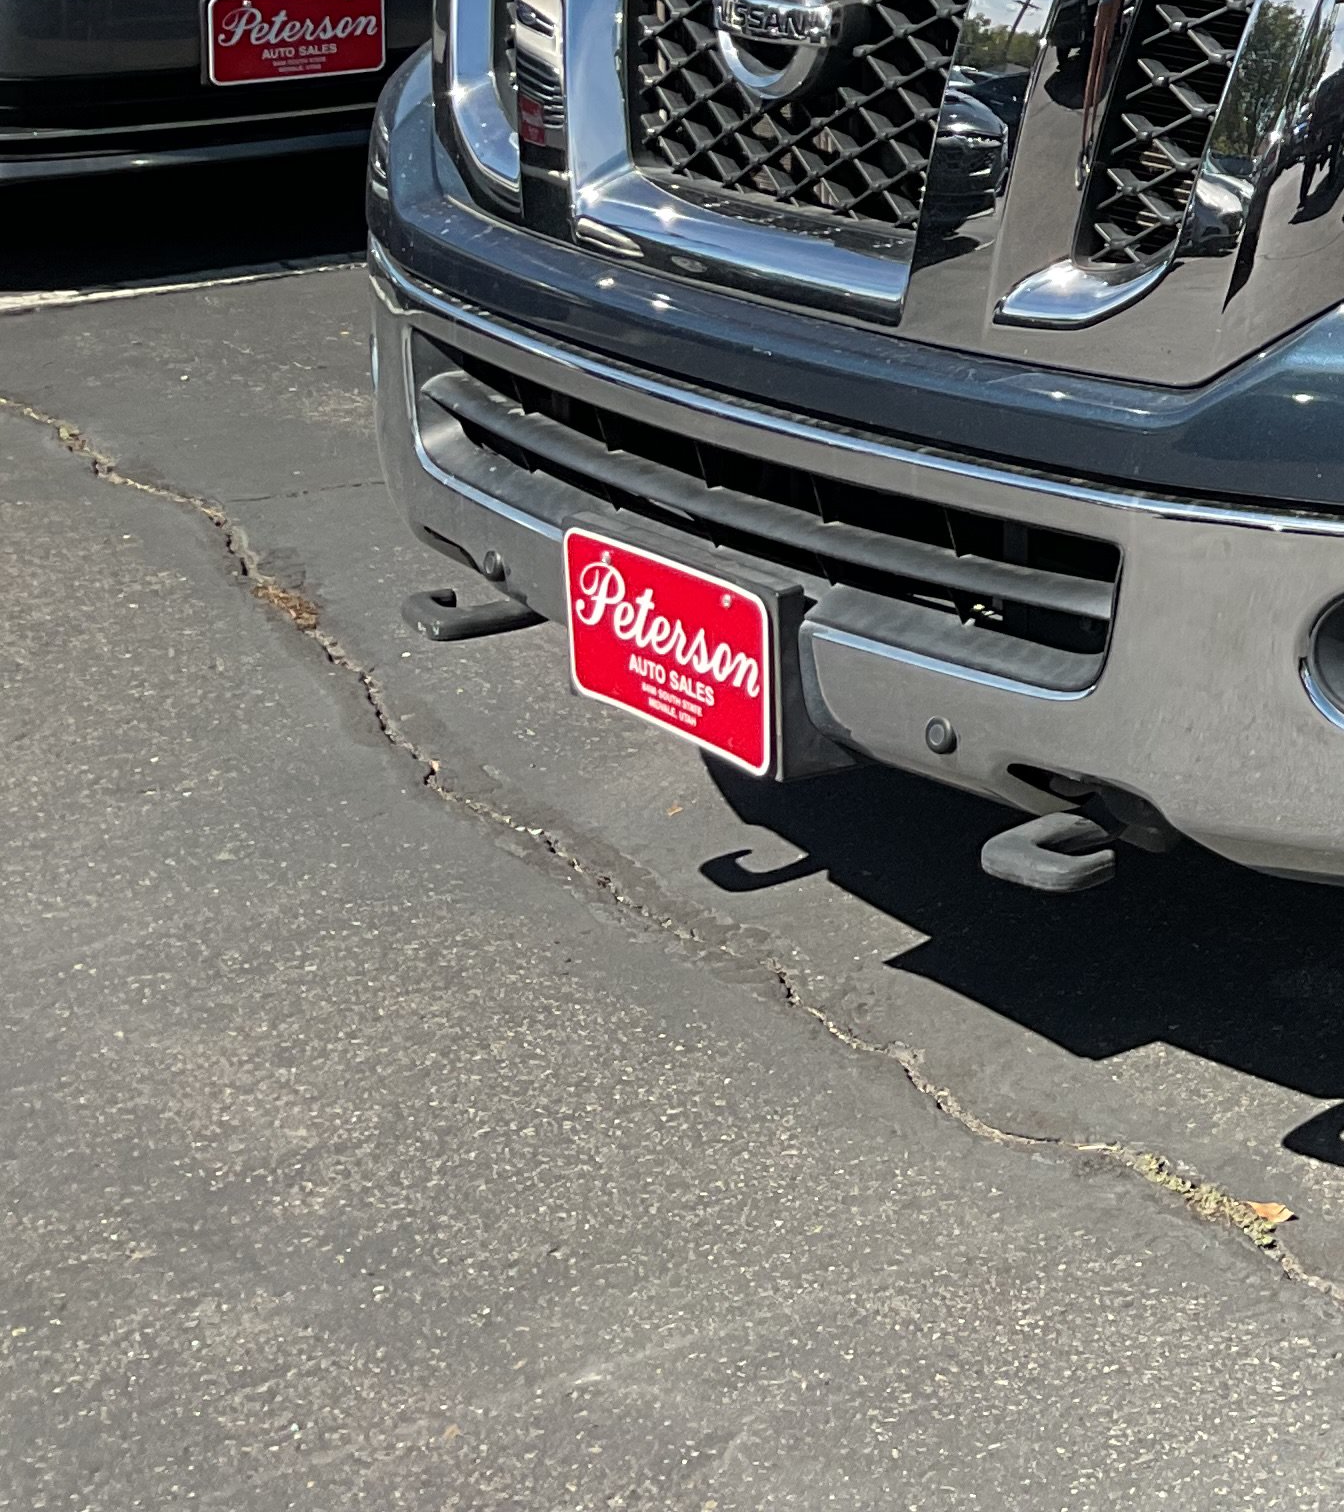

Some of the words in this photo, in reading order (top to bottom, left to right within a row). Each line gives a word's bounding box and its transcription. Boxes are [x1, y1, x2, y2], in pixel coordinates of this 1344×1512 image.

[217, 7, 378, 47] Peterson
[262, 46, 295, 60] AUTO
[298, 43, 337, 55] SALES
[575, 561, 760, 698] Peterson
[629, 654, 666, 685] AUTO
[669, 670, 715, 707] SALES
